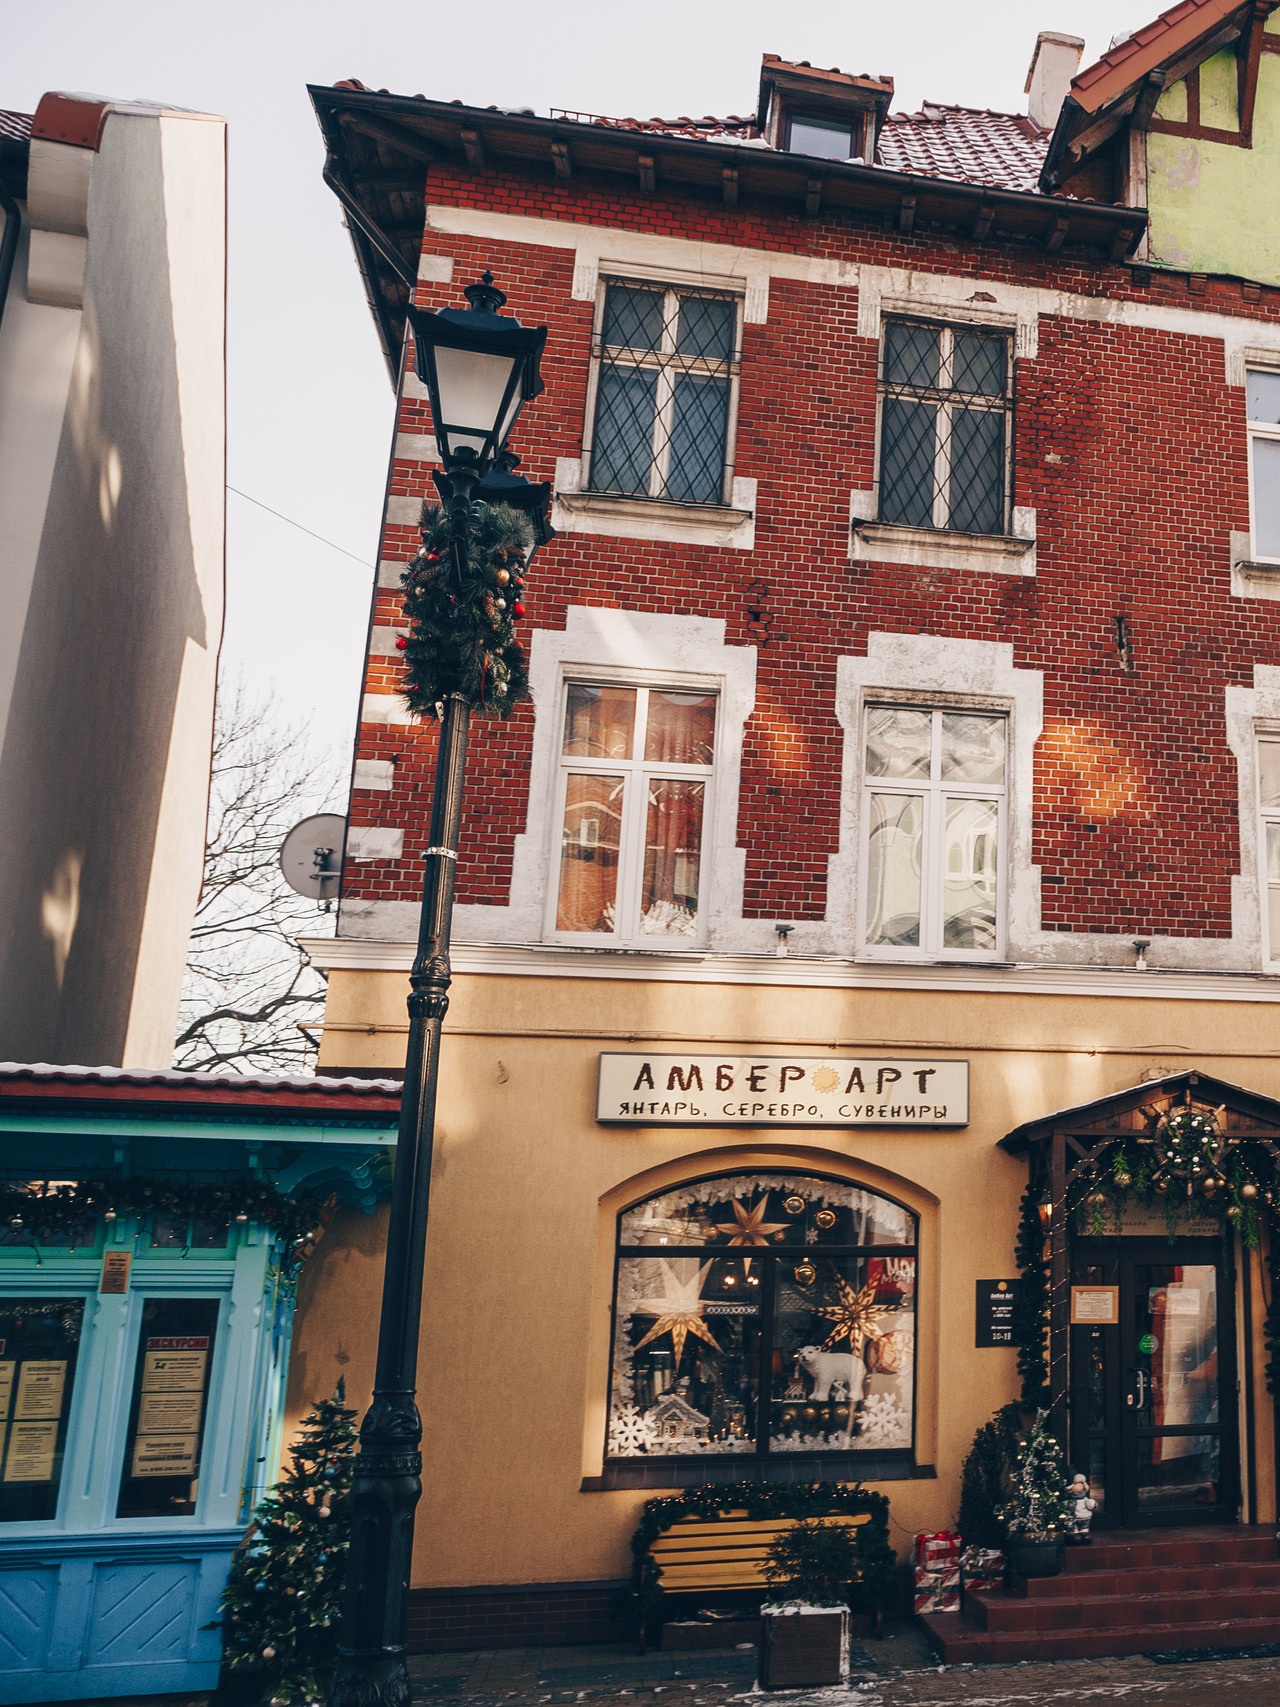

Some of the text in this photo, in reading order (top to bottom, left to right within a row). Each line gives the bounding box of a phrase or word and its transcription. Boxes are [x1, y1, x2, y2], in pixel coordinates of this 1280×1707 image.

[633, 1062, 937, 1095] АМБЕР АРТ
[618, 1101, 948, 1119] ЯНТАРЬ, СЕРЕБРО, СУВЕНИРЫ
